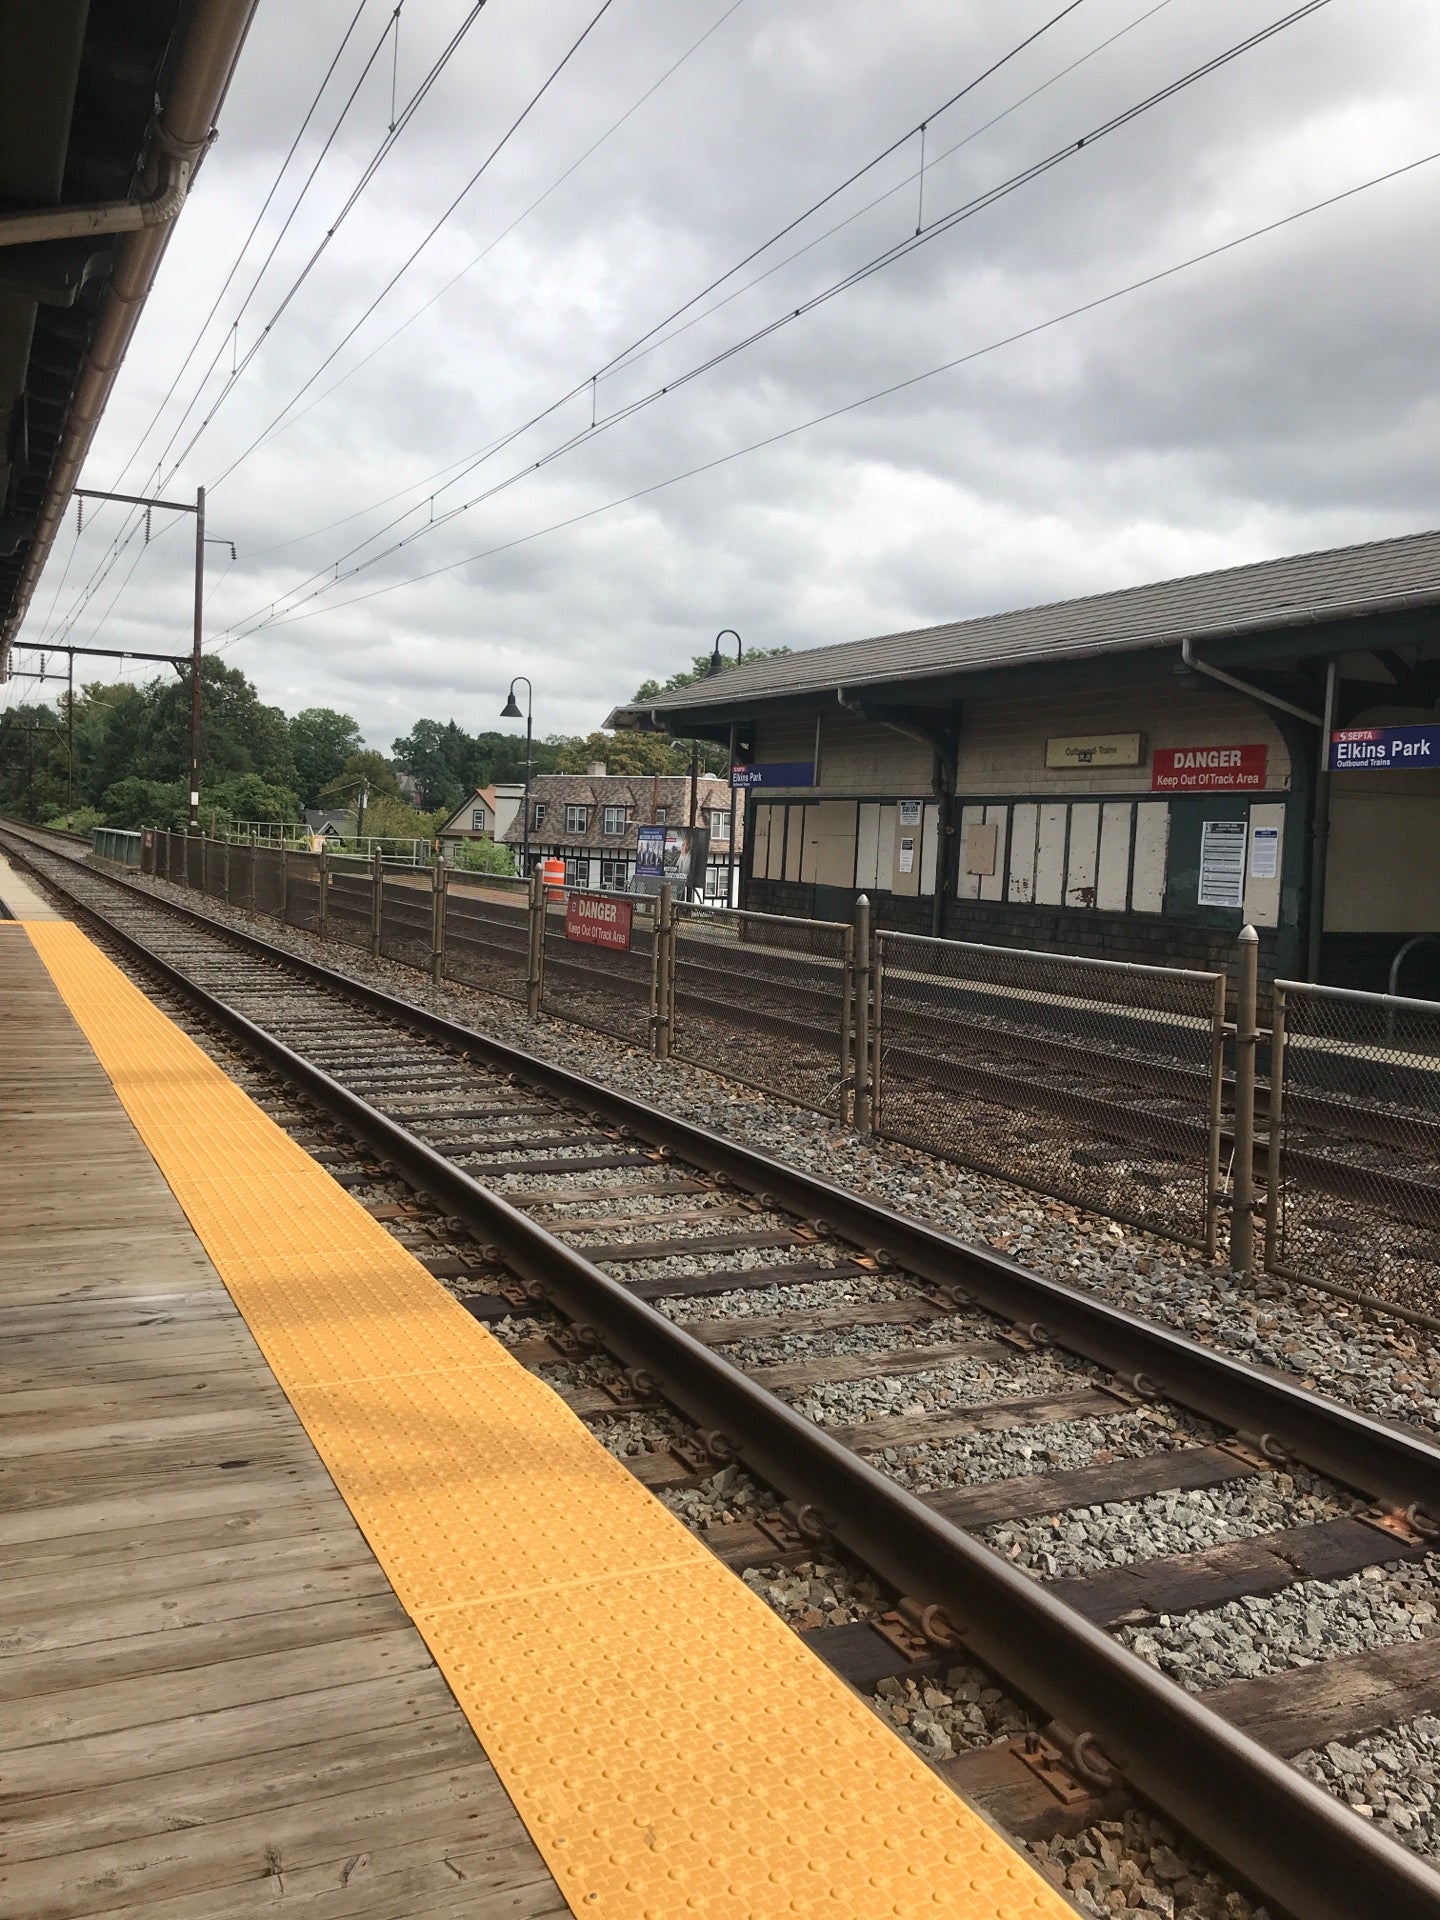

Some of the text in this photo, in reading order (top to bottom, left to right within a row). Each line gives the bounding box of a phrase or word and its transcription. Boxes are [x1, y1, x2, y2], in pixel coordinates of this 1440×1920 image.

[1348, 731, 1373, 740] SEPTA
[1338, 739, 1430, 758] Elkins Park
[1173, 750, 1242, 769] DANGER
[1337, 758, 1391, 767] Outbound Trains
[749, 771, 762, 782] Park
[1157, 773, 1259, 788] Keep Out Of Track Area
[578, 899, 617, 923] DANGER
[568, 922, 626, 944] Keep Out Of Track Area
